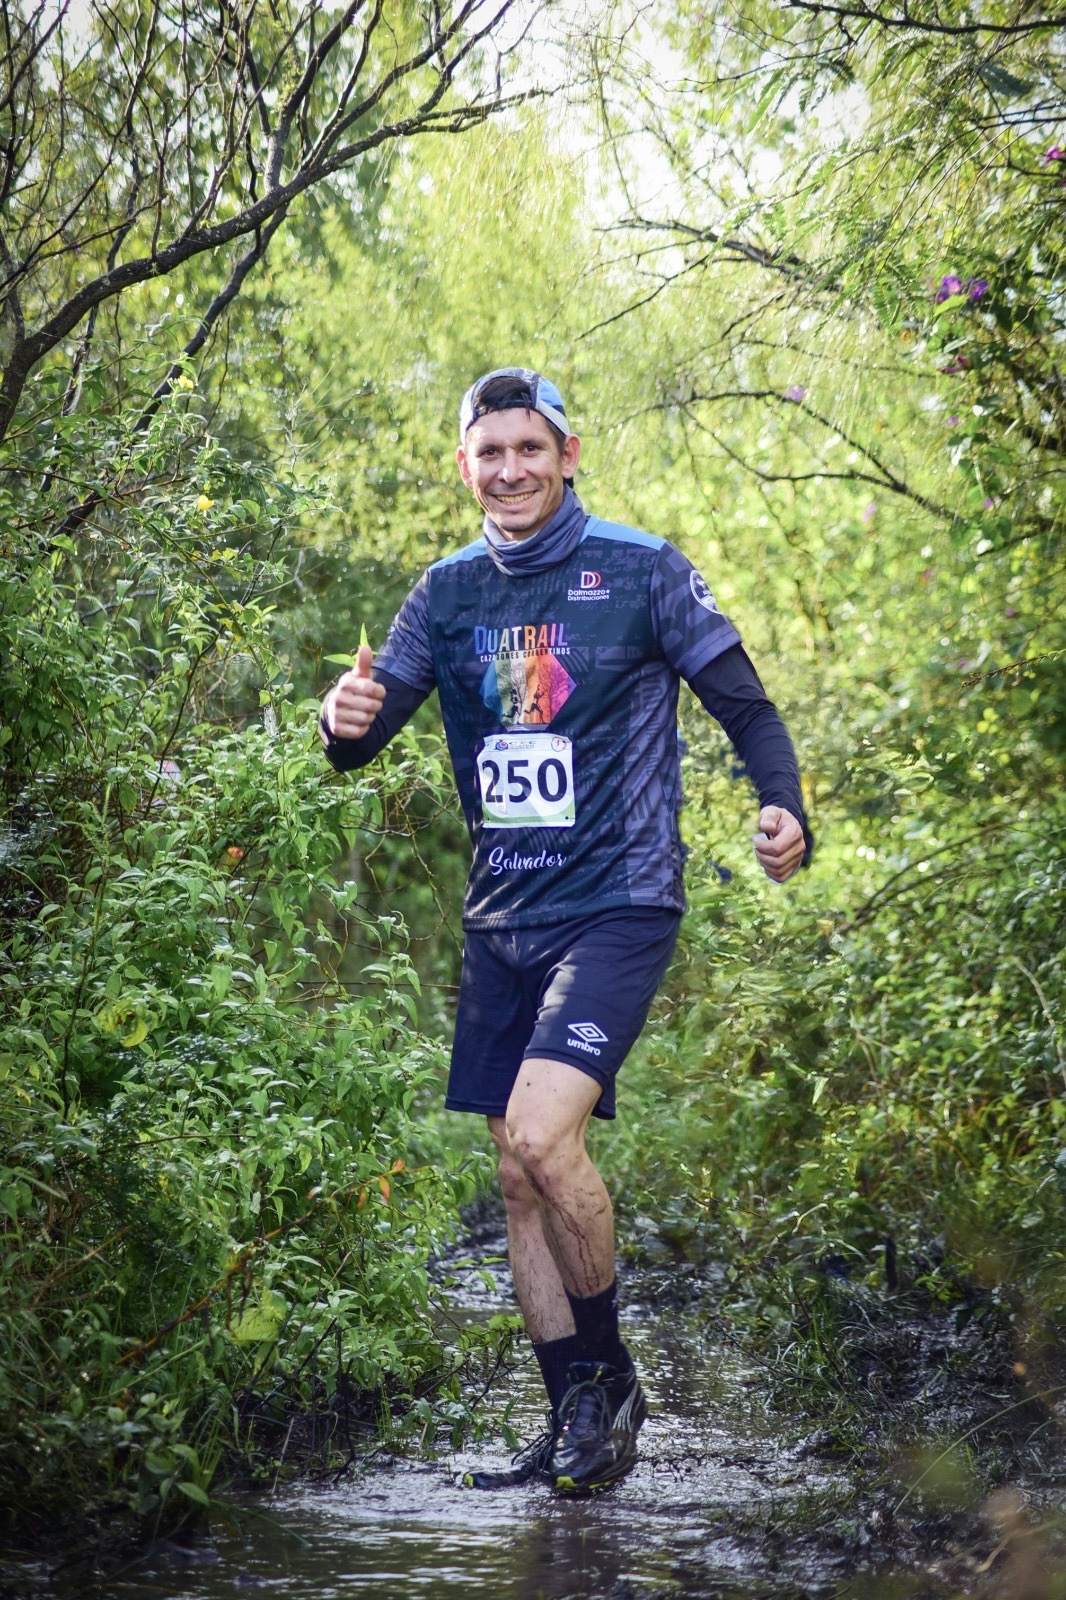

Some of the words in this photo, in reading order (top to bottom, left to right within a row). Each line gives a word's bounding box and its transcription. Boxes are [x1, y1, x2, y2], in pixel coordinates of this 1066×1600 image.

[474, 623, 568, 655] DUATRAIL
[480, 651, 520, 663] CAZADORES
[522, 647, 571, 659] CORRENTINOS
[481, 758, 568, 803] 250
[488, 846, 567, 876] Salvador
[567, 1038, 601, 1056] umbro
